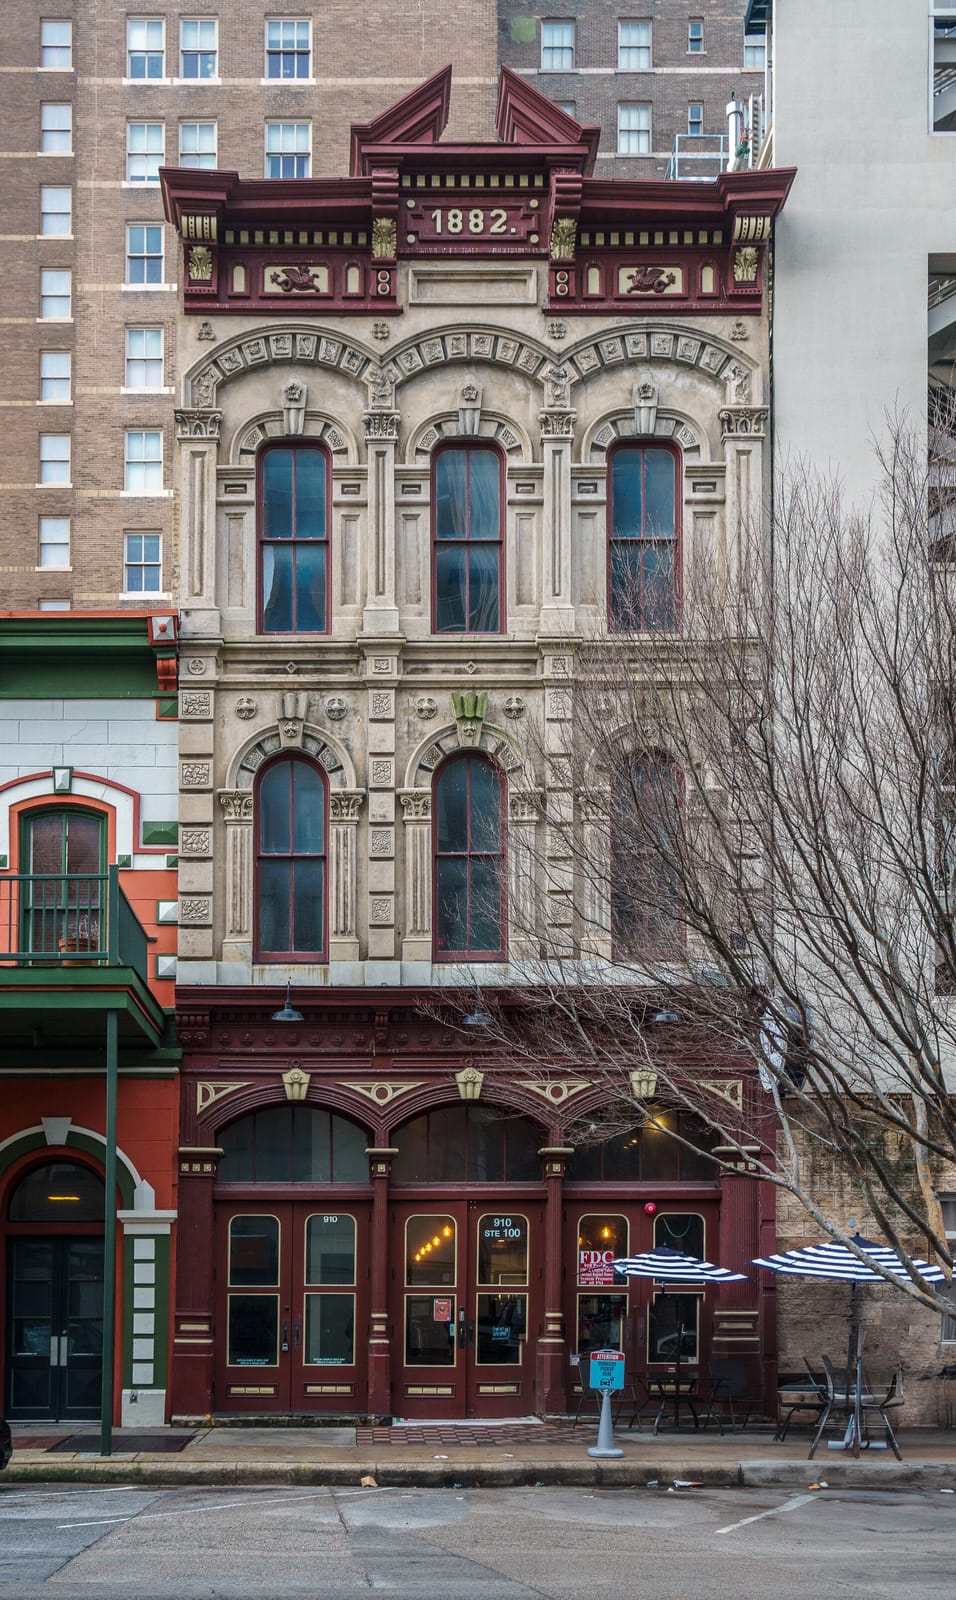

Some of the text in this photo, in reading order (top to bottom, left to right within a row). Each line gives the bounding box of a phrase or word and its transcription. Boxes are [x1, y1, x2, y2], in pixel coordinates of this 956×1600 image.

[431, 208, 516, 233] 1882.
[323, 1215, 338, 1223] 910
[493, 1217, 512, 1227] 910
[484, 1228, 521, 1238] STE 100
[580, 1251, 614, 1264] FDC
